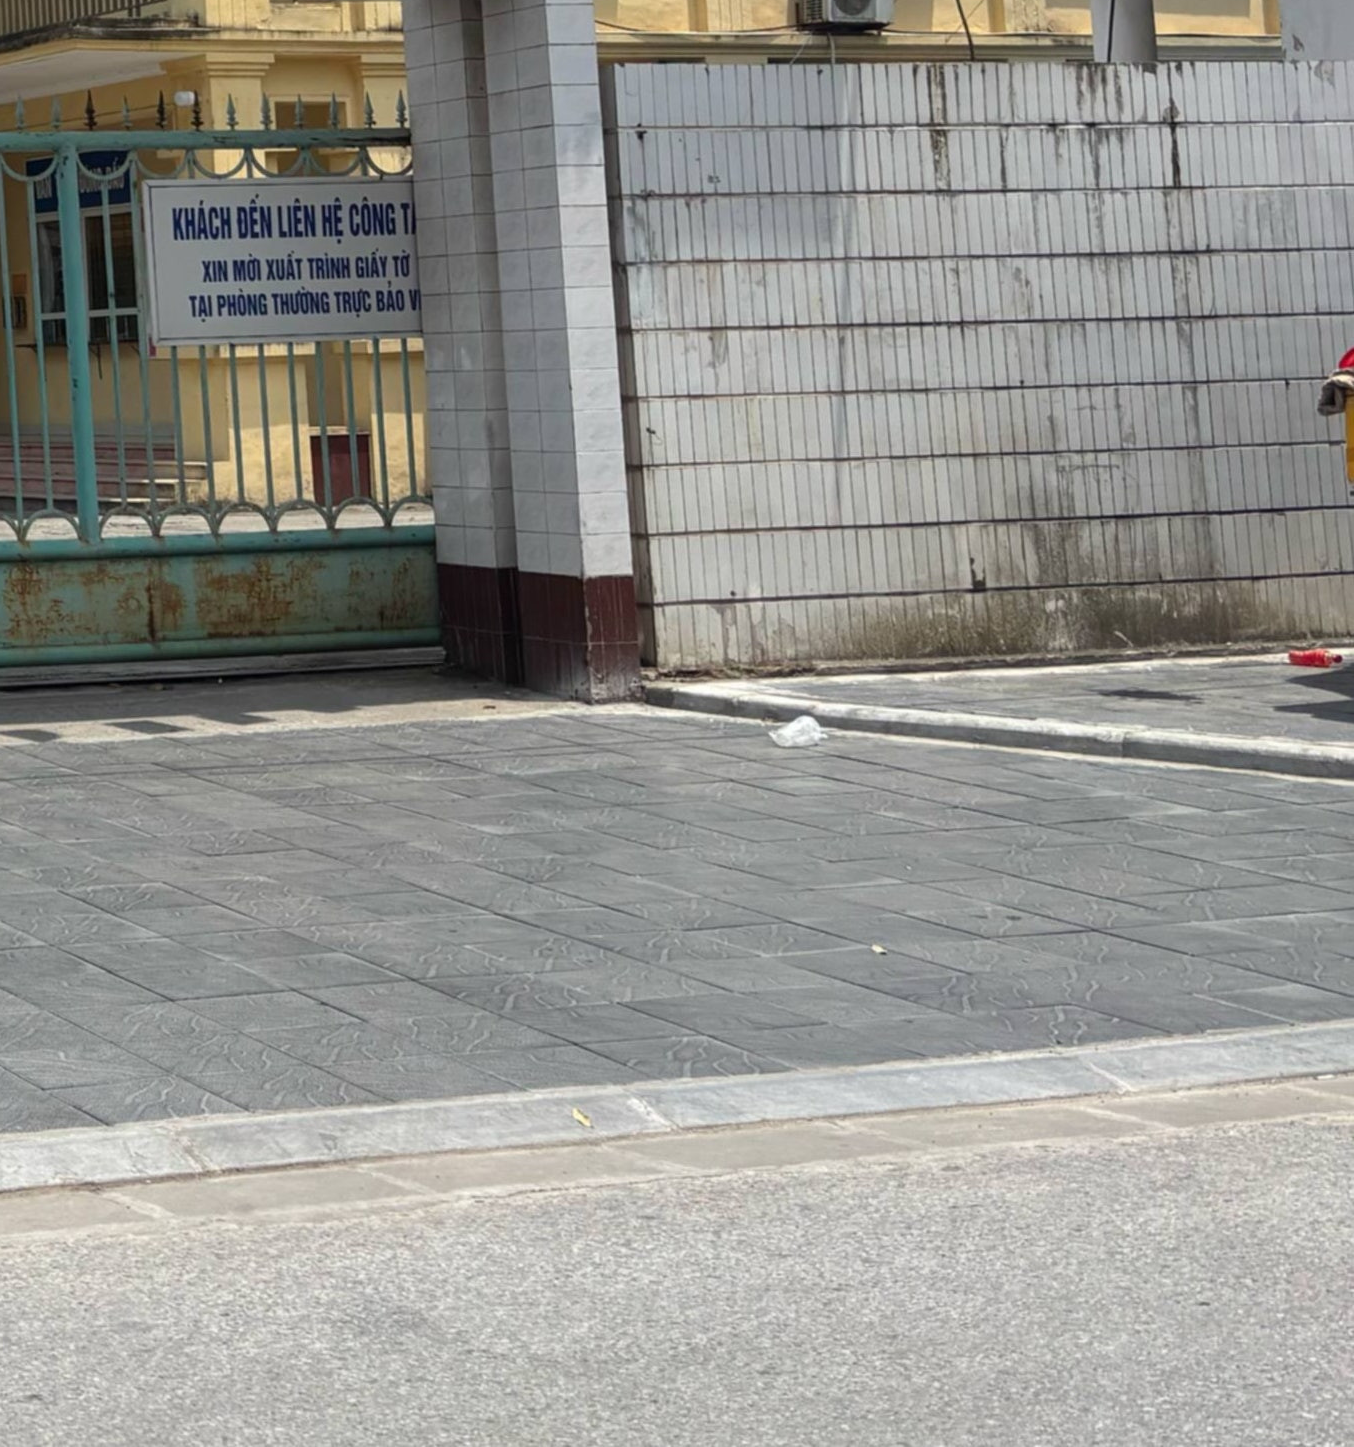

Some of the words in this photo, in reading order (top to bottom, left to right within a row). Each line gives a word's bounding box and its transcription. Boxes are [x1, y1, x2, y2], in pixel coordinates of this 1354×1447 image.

[172, 199, 232, 241] KHÁCH
[236, 193, 273, 239] ĐẾN
[277, 198, 317, 238] LIÊN
[322, 196, 344, 244] HỆ
[348, 196, 396, 237] CÔNG
[202, 260, 228, 283] XIN
[232, 253, 261, 282] MỜI
[266, 250, 303, 281] XUẤT
[307, 253, 351, 280] TRÌNH
[355, 248, 390, 278] GIẤY
[392, 249, 410, 277] TỜ
[189, 294, 213, 323] TẠI
[217, 288, 268, 317] PHÒNG
[271, 286, 330, 315] THƯỜNG
[333, 288, 372, 318] TRỰC
[376, 280, 405, 312] BẢO
